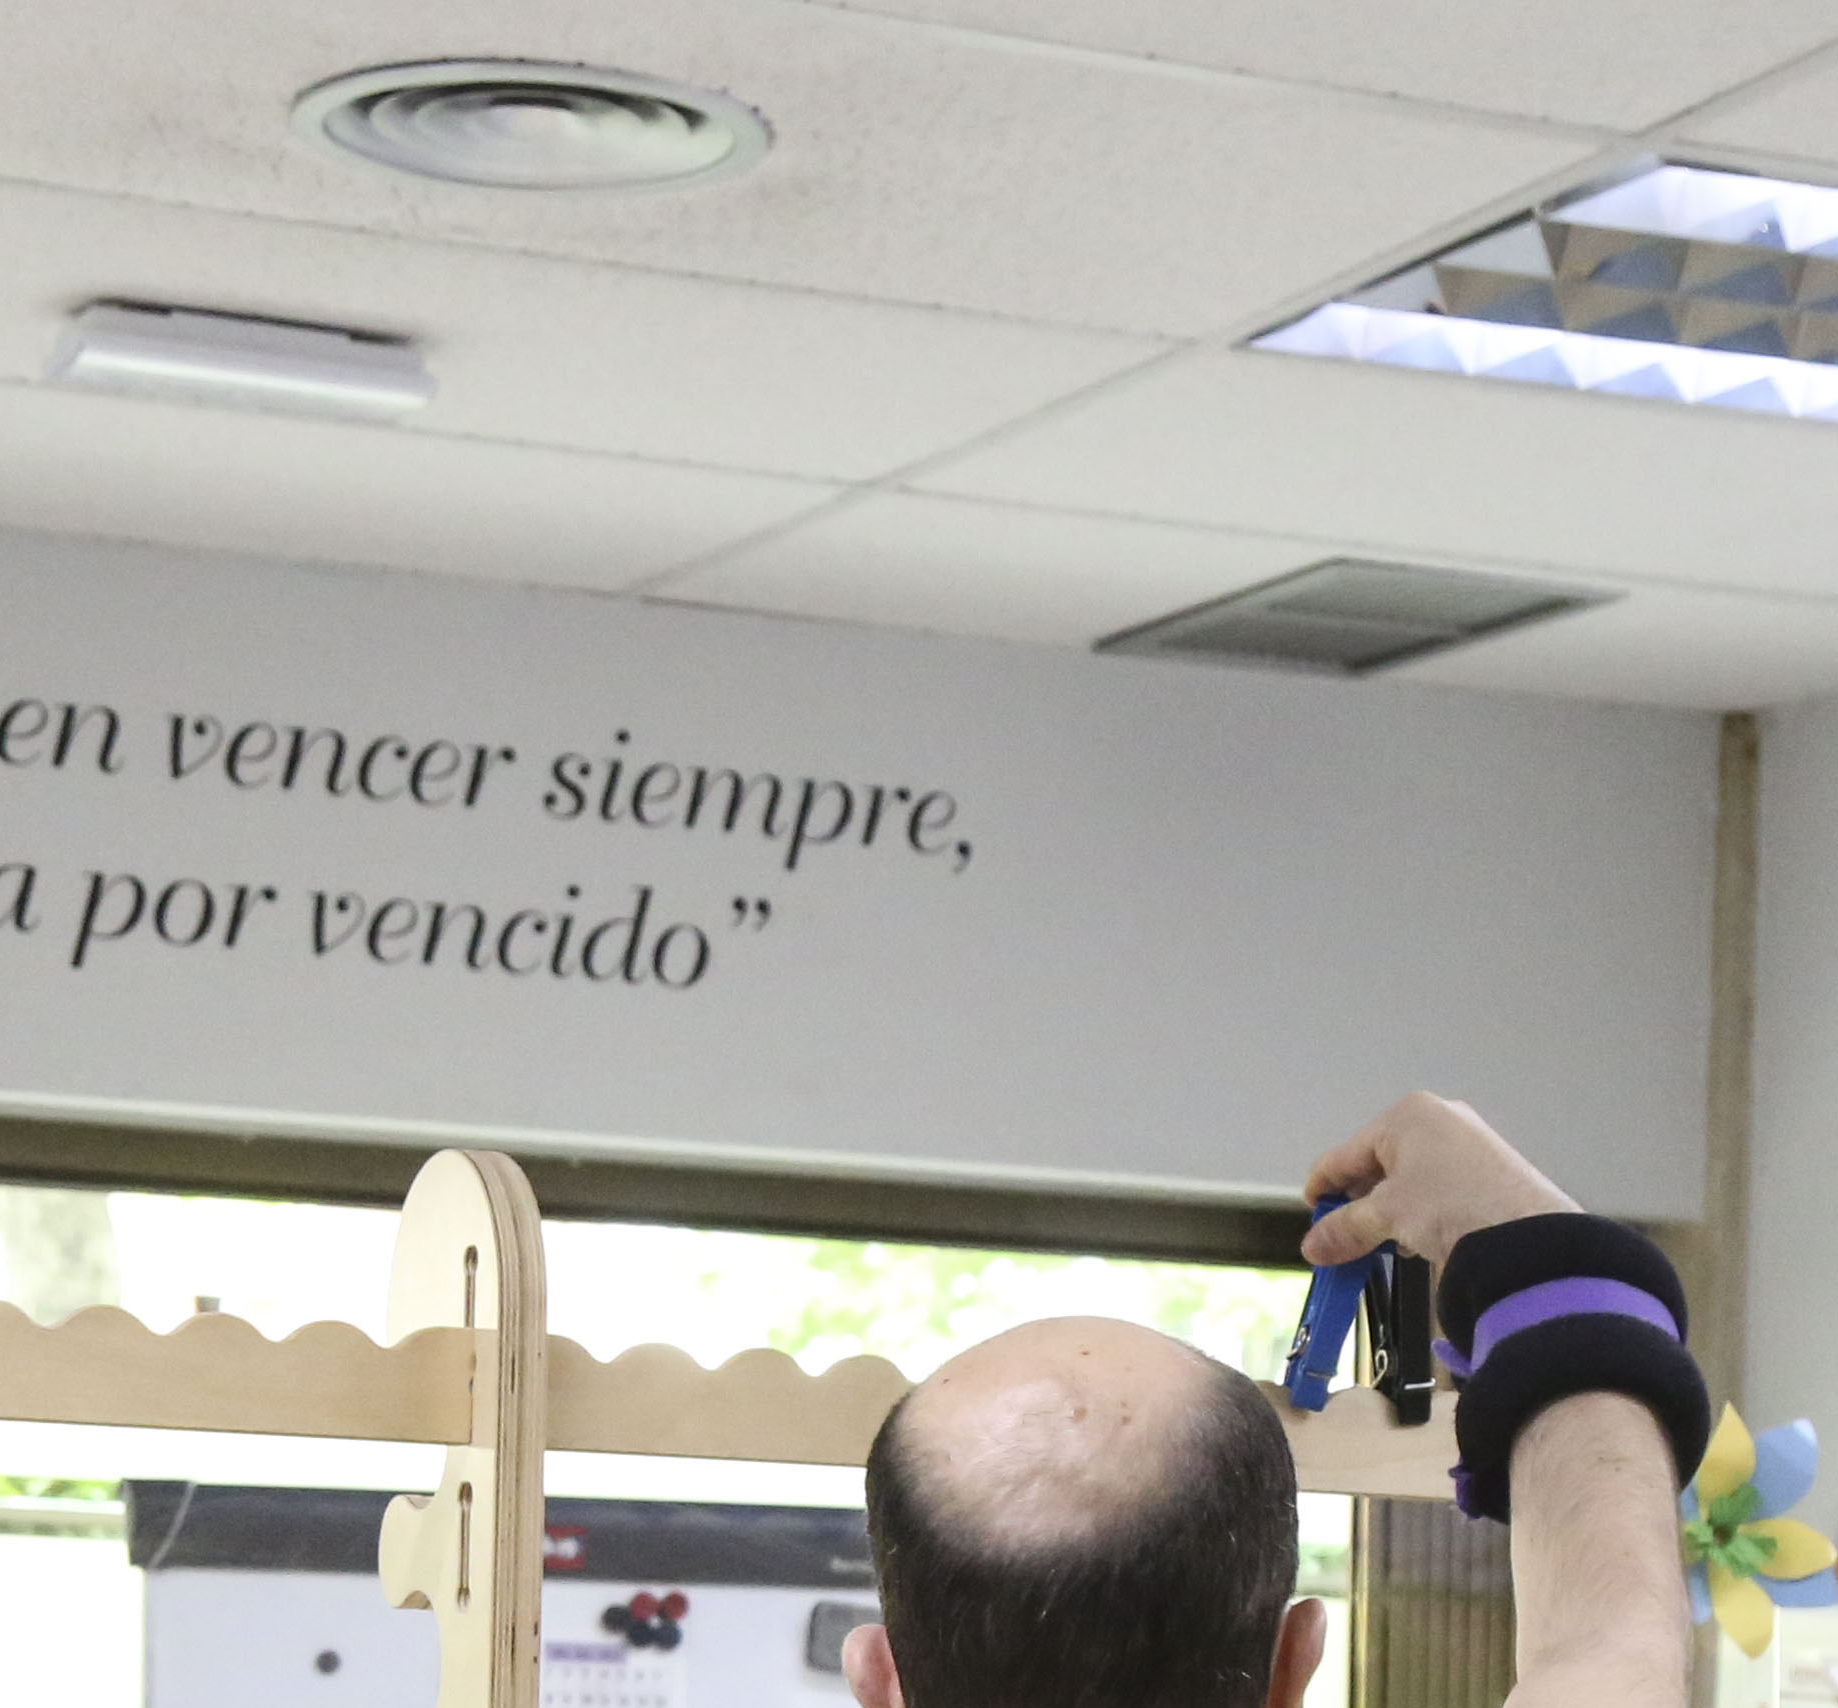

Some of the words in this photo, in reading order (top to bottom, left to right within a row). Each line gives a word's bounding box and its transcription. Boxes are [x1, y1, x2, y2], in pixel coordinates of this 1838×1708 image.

[167, 712, 516, 807] vencer
[542, 728, 972, 872] siempre,
[70, 868, 278, 969] por
[312, 884, 771, 988] vencido”
